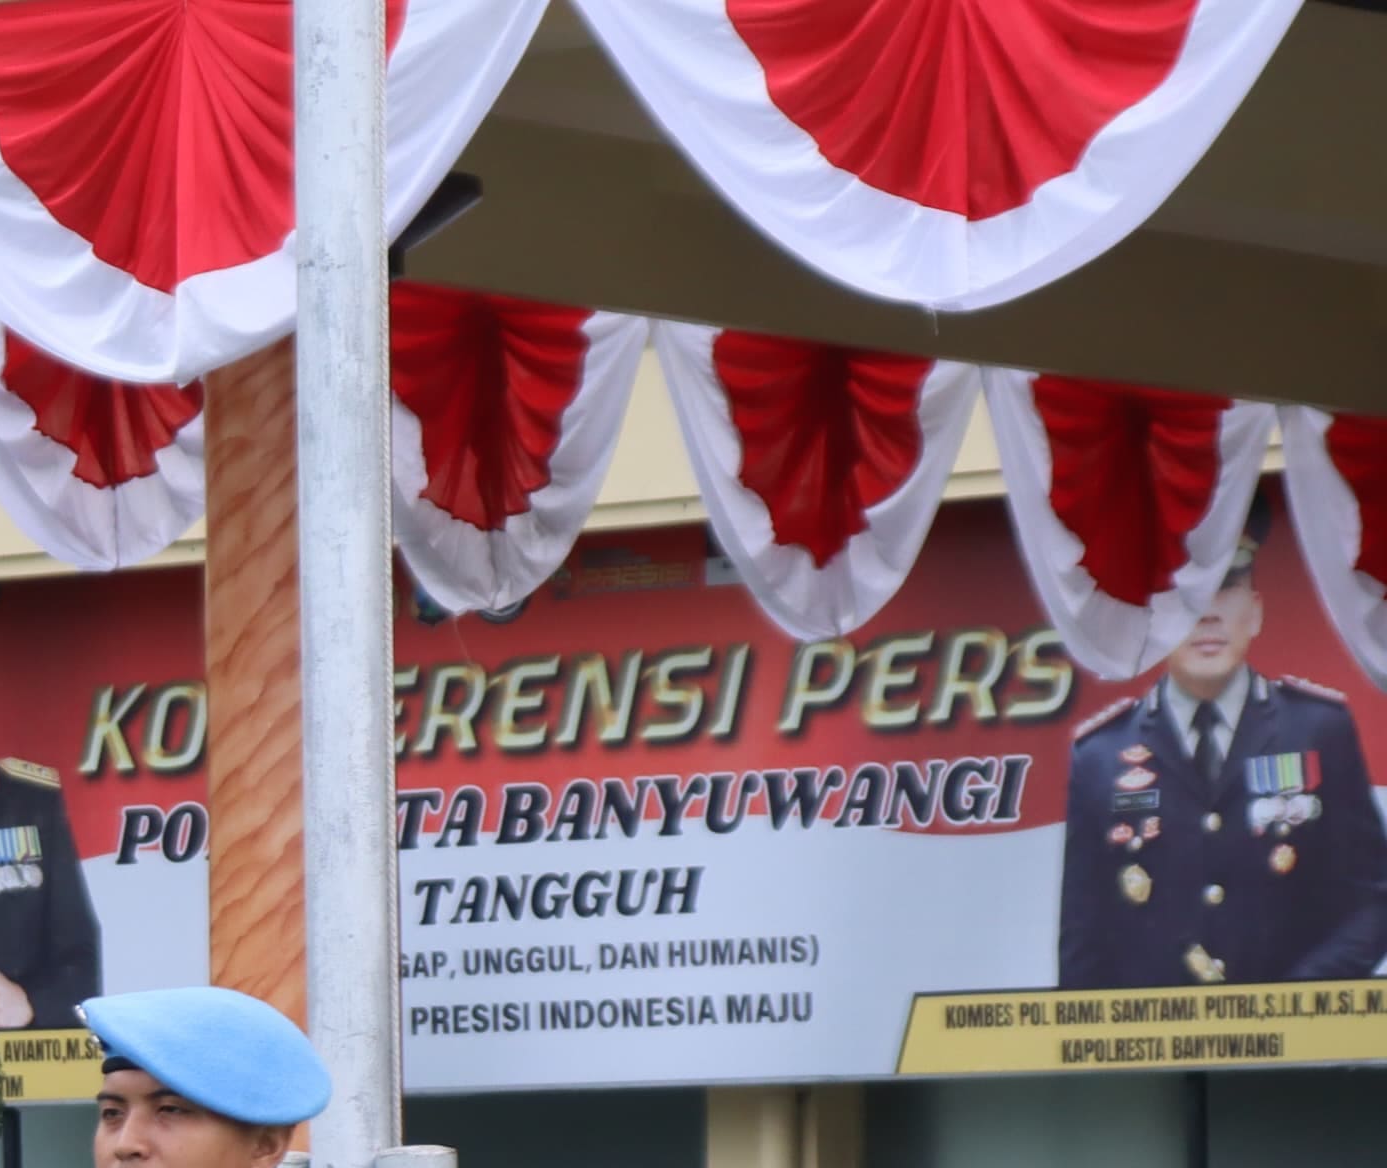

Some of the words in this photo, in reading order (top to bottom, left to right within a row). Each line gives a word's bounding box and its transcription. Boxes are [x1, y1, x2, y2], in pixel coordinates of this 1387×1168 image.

[777, 629, 1073, 734] PERS
[494, 755, 1031, 846] BANYUWANGI
[414, 866, 705, 925] TANGGUH
[462, 945, 591, 977] UNGGUL,
[599, 942, 659, 971] DAN
[668, 934, 820, 969] HUMANIS)
[410, 1001, 528, 1035] PRESISI
[539, 996, 717, 1031] INDONESIA
[725, 992, 814, 1025] MAJU
[945, 1004, 1014, 1029] KOMBES
[1020, 1002, 1050, 1027] POL
[1056, 1000, 1106, 1025] RAMA
[1111, 996, 1199, 1023] SAMTAMA
[1061, 1037, 1167, 1064] KAPOLRESTA
[1172, 1032, 1285, 1060] BANYUWANGI
